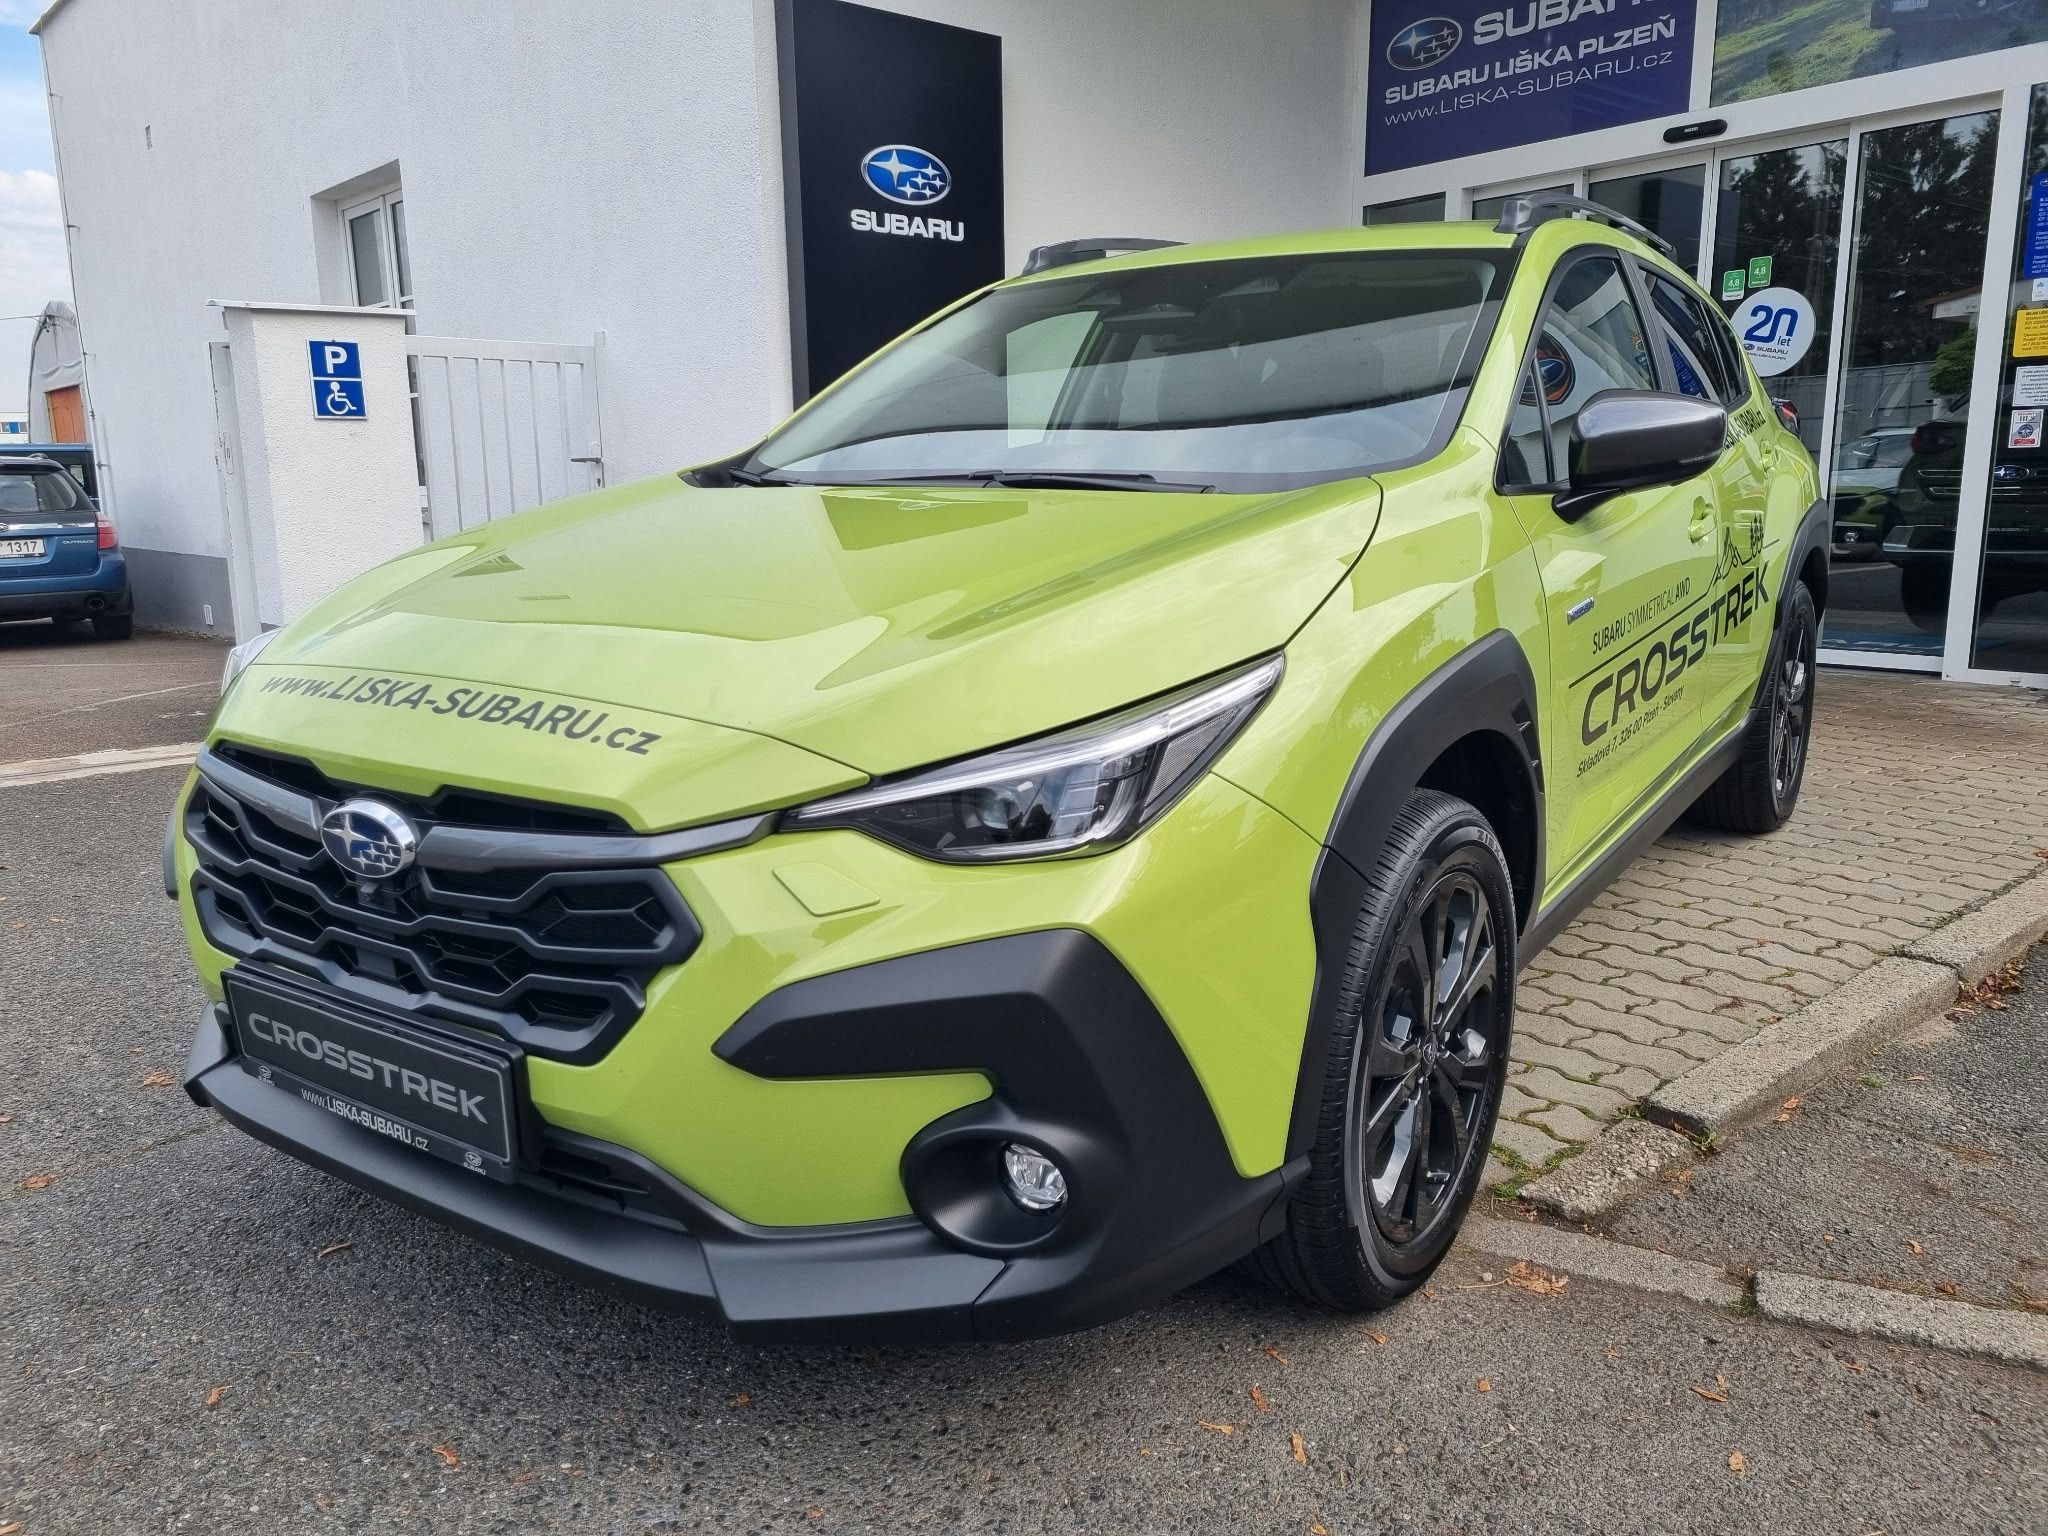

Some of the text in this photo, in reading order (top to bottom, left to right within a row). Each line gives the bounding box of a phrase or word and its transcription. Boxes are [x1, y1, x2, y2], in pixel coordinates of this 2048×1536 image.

[1474, 0, 1656, 46] SUBA
[1385, 14, 1677, 105] SUBARU LIŠKA PLZEŇ
[1384, 50, 1674, 126] www.LISKA-SUBARU.cz
[850, 208, 965, 242] SUBARU
[1754, 266, 1767, 276] 4,8
[1744, 304, 1799, 344] 20
[1777, 336, 1792, 347] let
[325, 346, 347, 374] P
[1756, 346, 1789, 355] SUBARU
[6, 541, 37, 553] 1317
[1581, 560, 1770, 747] CROSSTREK
[1592, 618, 1627, 655] SUBARU
[259, 675, 661, 756] www.LISKA-SUBARU.cz
[247, 1012, 488, 1124] CROSSTREK
[301, 1088, 429, 1151] www.LISKA-SUBARU.cz
